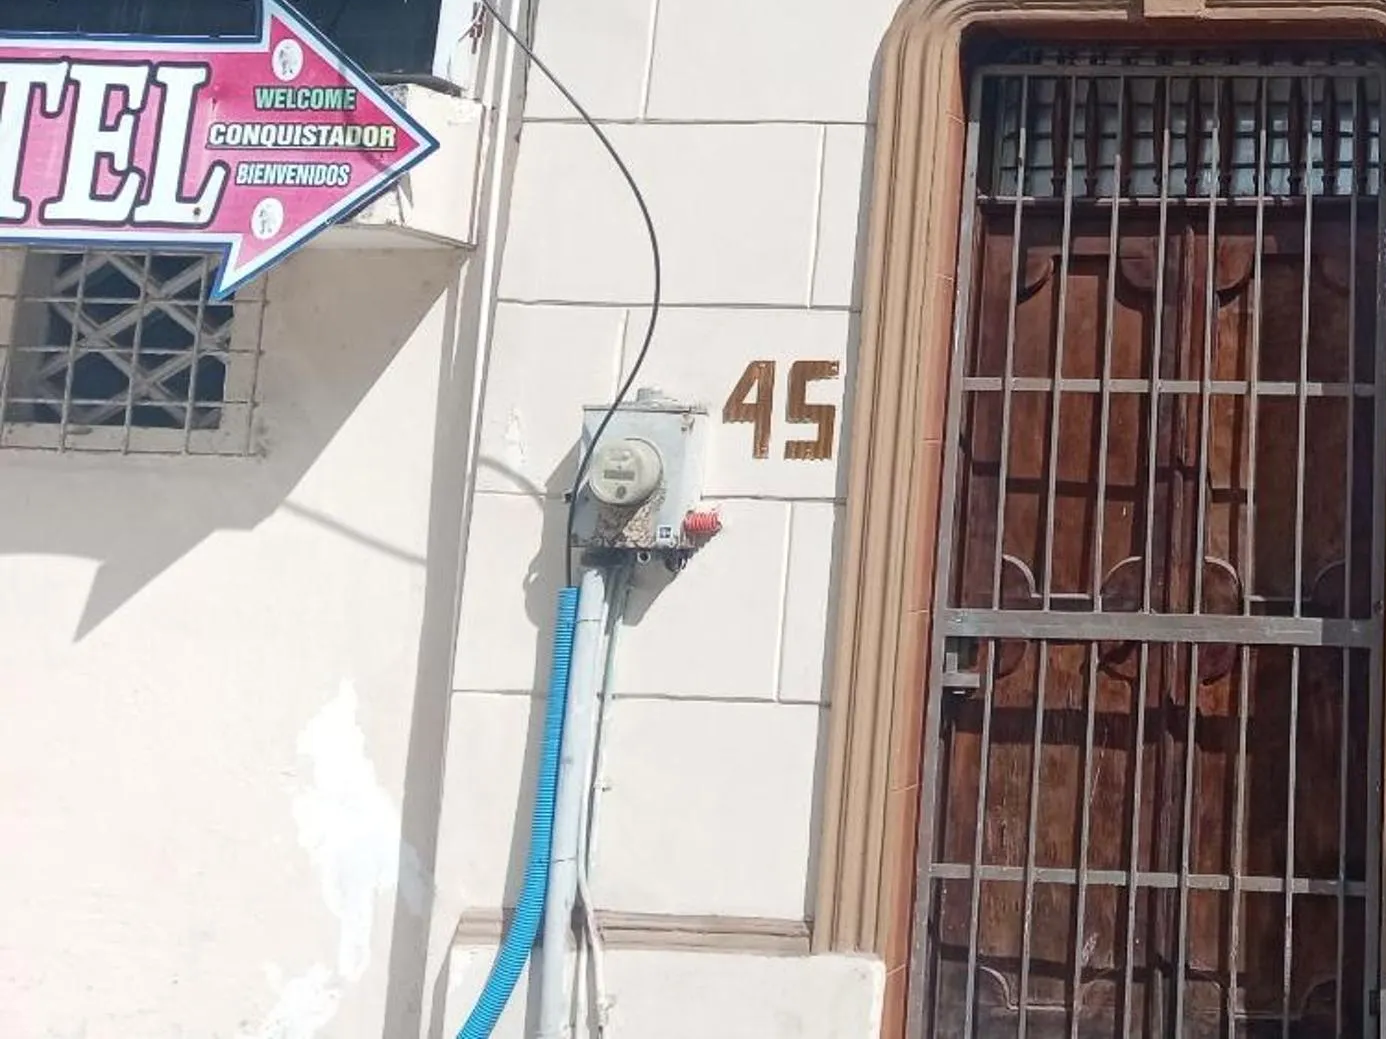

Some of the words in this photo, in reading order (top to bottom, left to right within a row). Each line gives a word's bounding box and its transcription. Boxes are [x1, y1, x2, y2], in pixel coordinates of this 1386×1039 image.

[254, 86, 359, 112] WELCOME
[206, 122, 398, 150] CONQUISTADOR
[235, 163, 352, 187] BIENVENIDOS
[722, 360, 840, 459] 45
